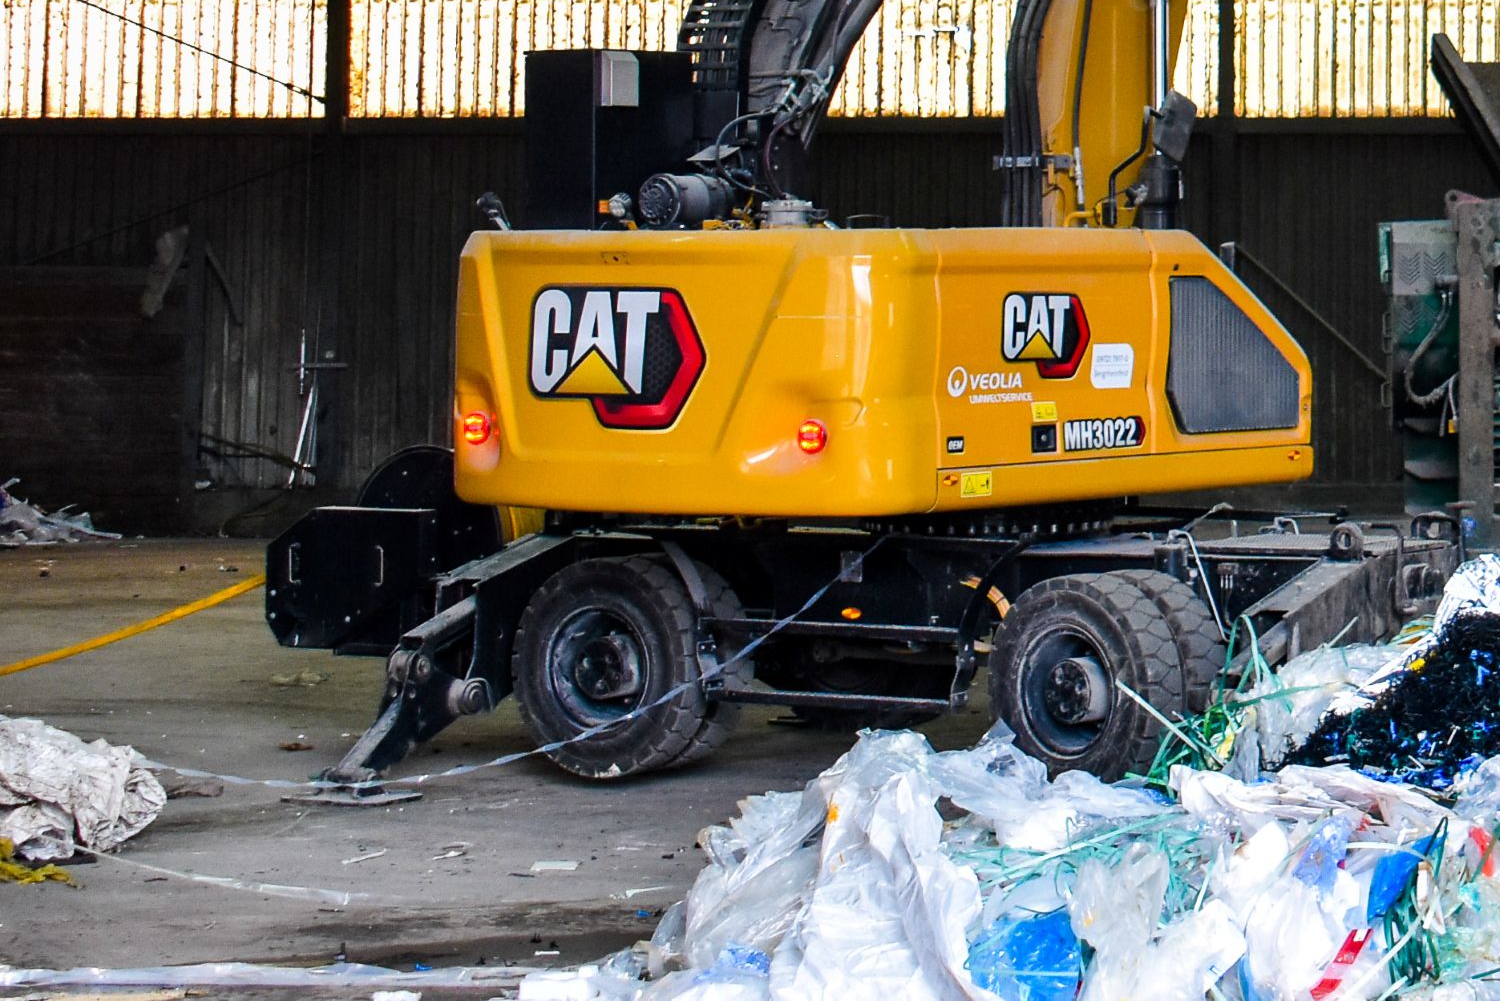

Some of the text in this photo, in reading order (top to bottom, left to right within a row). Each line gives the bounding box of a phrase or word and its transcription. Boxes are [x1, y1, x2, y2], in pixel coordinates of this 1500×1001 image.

[531, 289, 661, 395] CAT
[1003, 294, 1070, 359] CAT
[970, 372, 1022, 390] VEOLIA
[1064, 418, 1137, 451] MH3022
